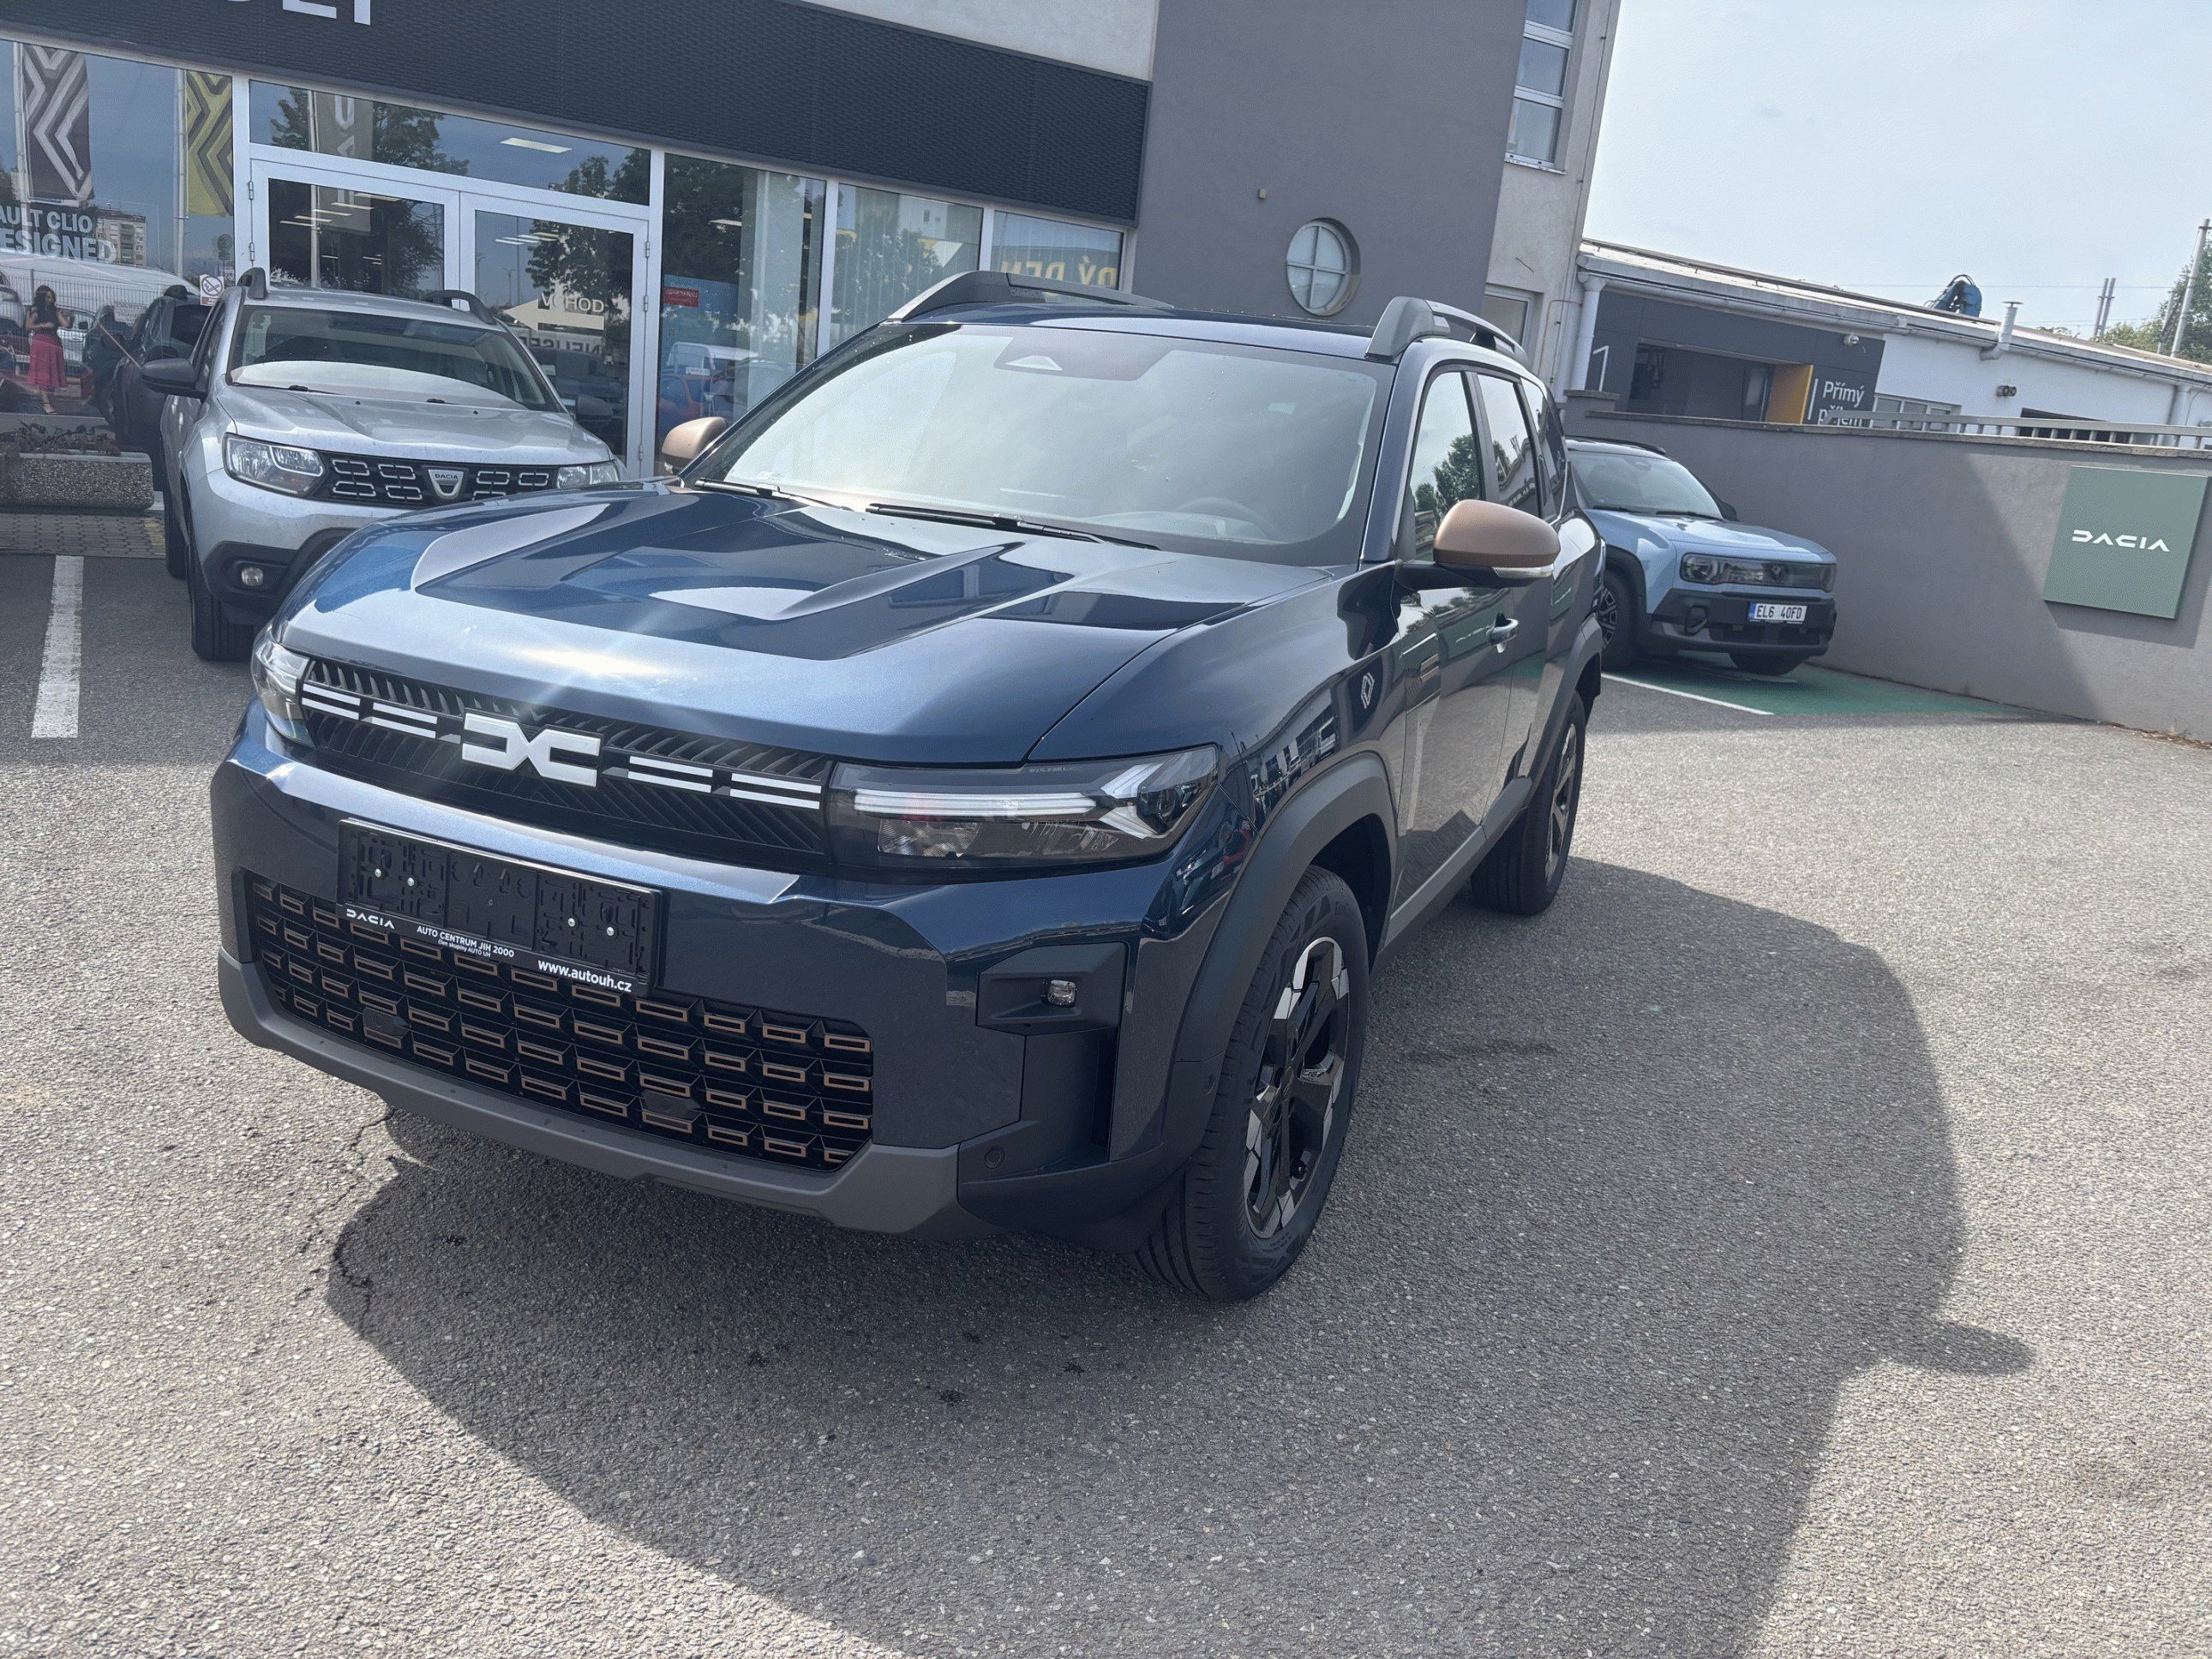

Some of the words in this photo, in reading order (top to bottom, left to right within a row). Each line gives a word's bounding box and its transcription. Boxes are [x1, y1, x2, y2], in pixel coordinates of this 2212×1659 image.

[46, 211, 93, 234] CLIO
[0, 227, 117, 263] ESIGNED
[541, 292, 604, 313] VCHOD
[1592, 345, 1610, 392] 1
[1822, 380, 1865, 408] Přímý
[2071, 530, 2170, 553] DACIA
[1756, 605, 1775, 618] EL6
[1780, 606, 1802, 620] 40FD
[346, 908, 395, 930] DACIA
[417, 925, 438, 937] AUTO
[439, 931, 477, 948] CENTRUM
[478, 941, 491, 952] JIH
[493, 945, 514, 958] 2000
[448, 942, 468, 953] skupiny
[537, 960, 632, 992] www.autouh.cz
